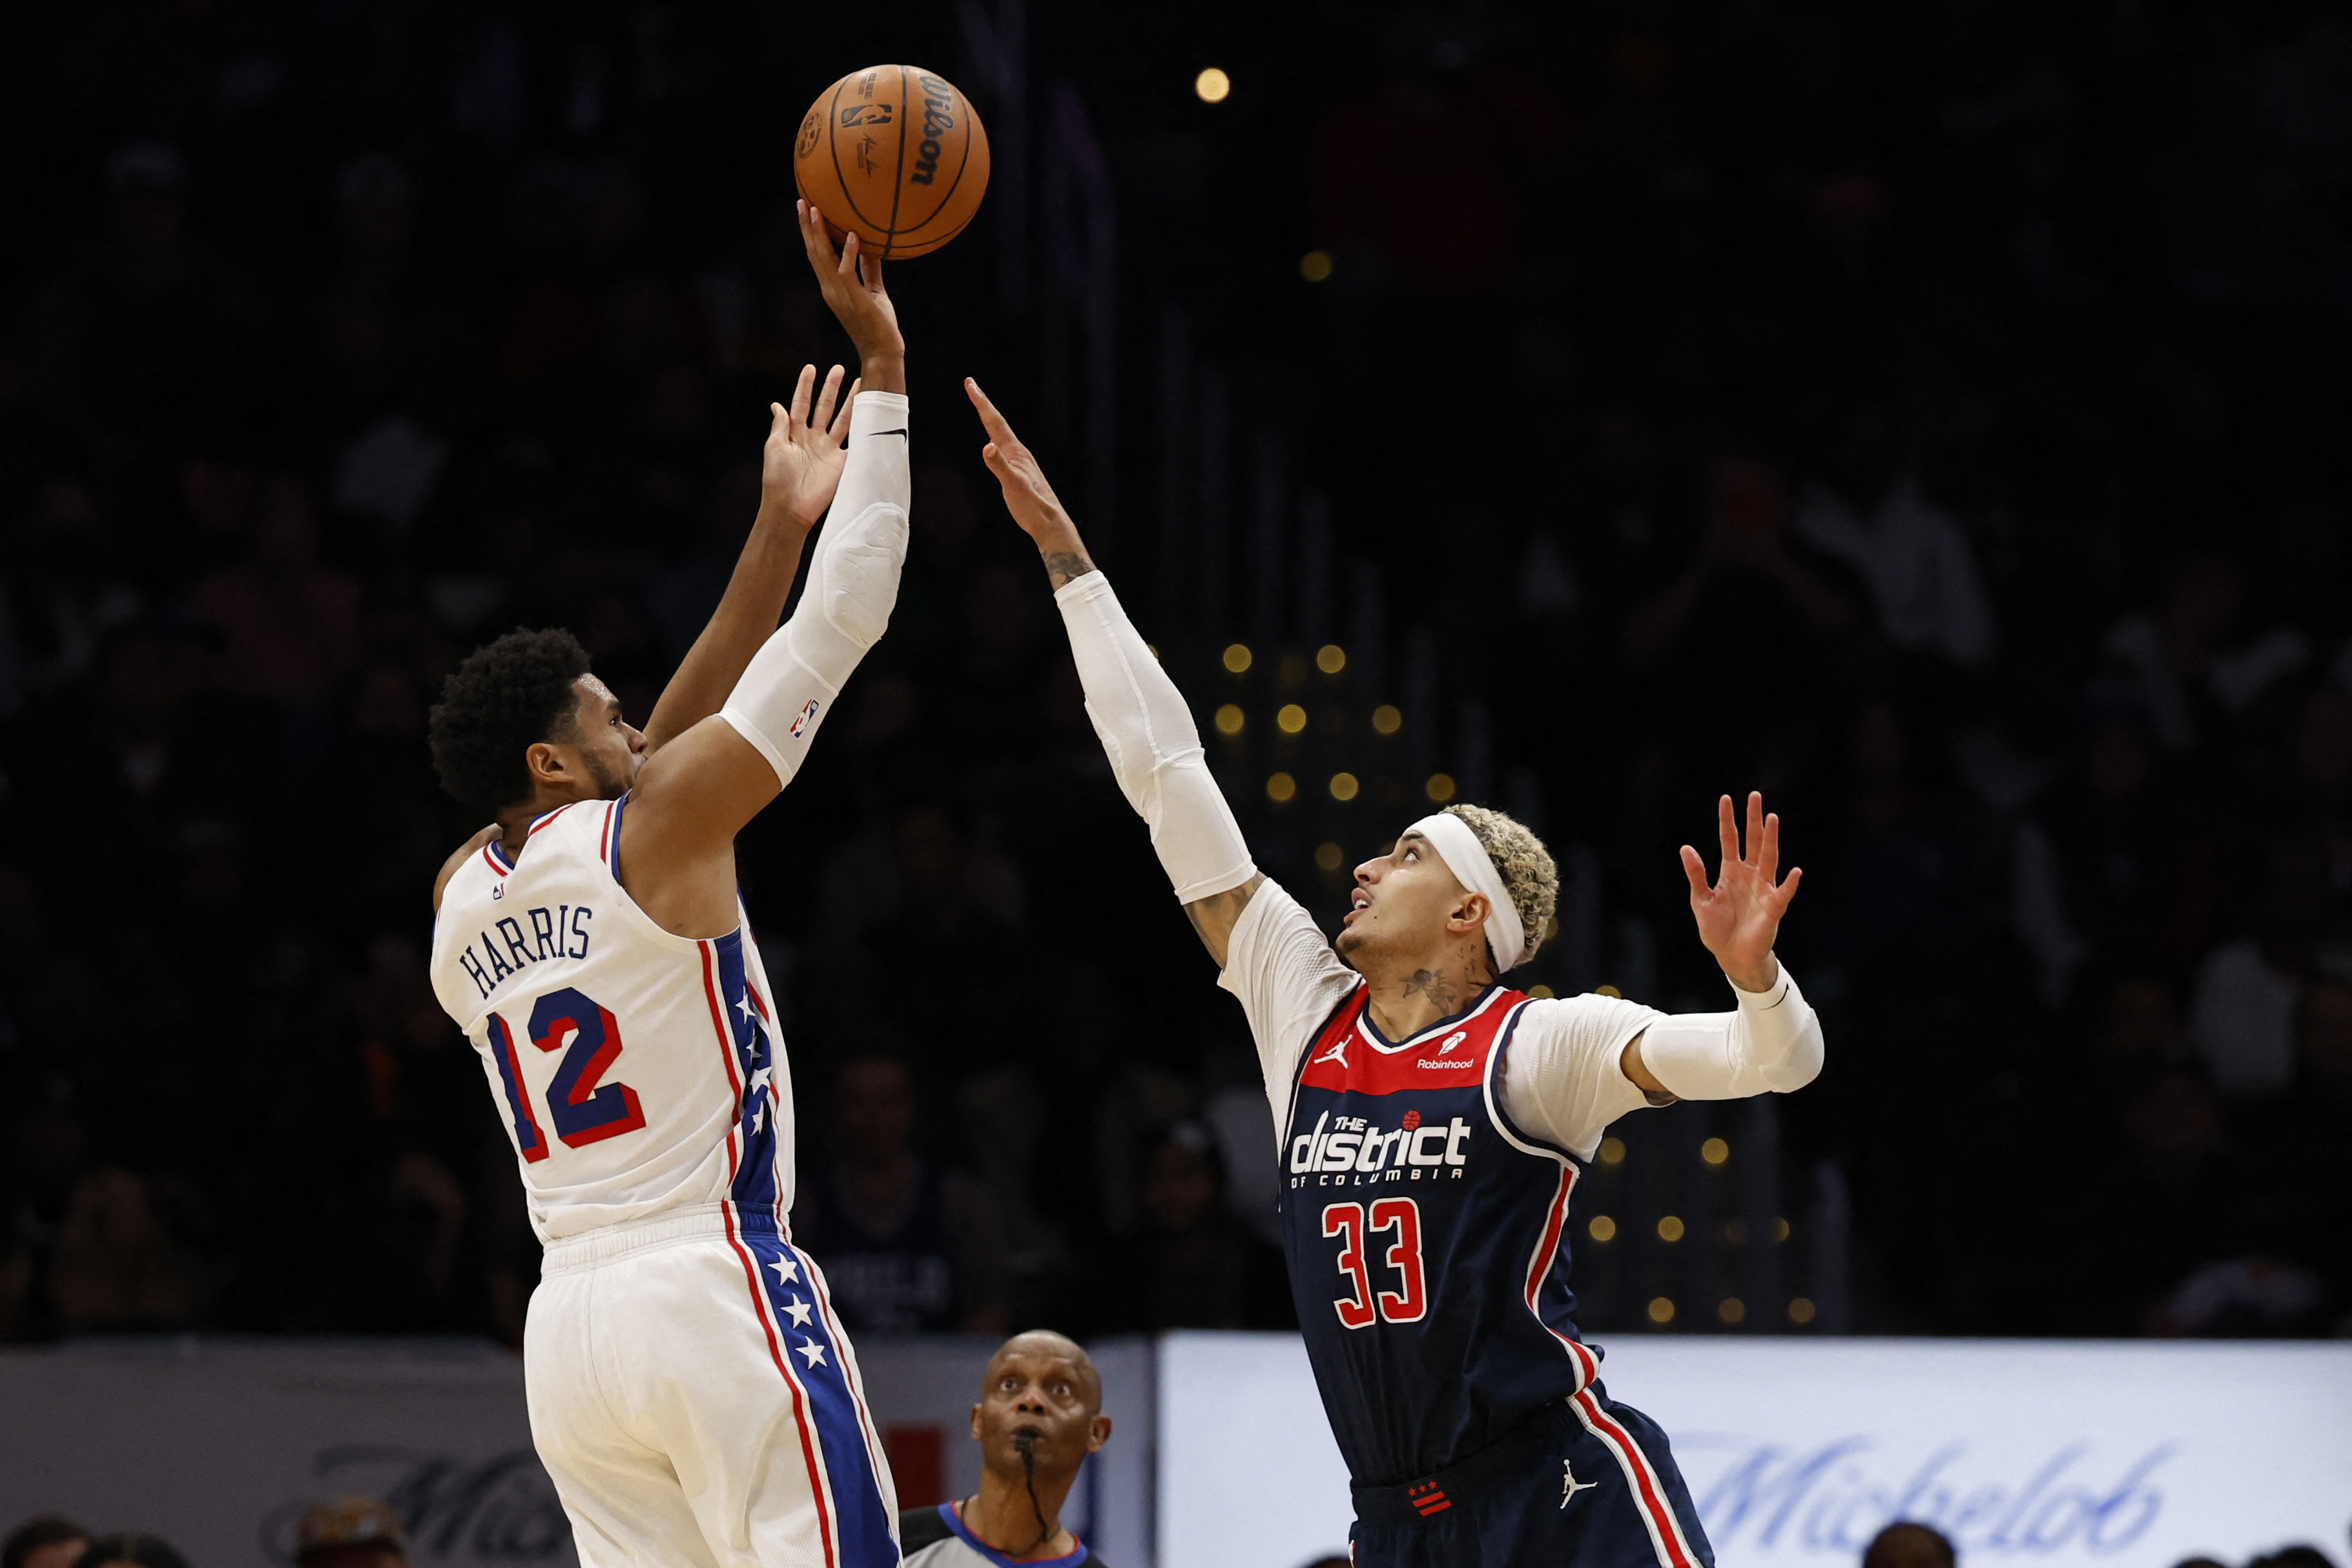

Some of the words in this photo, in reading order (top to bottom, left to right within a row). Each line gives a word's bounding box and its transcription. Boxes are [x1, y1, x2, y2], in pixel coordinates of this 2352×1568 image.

[910, 76, 954, 186] Wilson
[459, 905, 592, 1000] HARRIS
[486, 986, 646, 1164] 12
[1417, 1058, 1474, 1069] Robinhood
[1290, 1109, 1471, 1174] district
[1334, 1115, 1368, 1132] THE
[1290, 1175, 1306, 1190] OF
[1319, 1168, 1463, 1187] COLUMBIA
[1321, 1196, 1428, 1330] 33
[1670, 1430, 2182, 1558] Michelob
